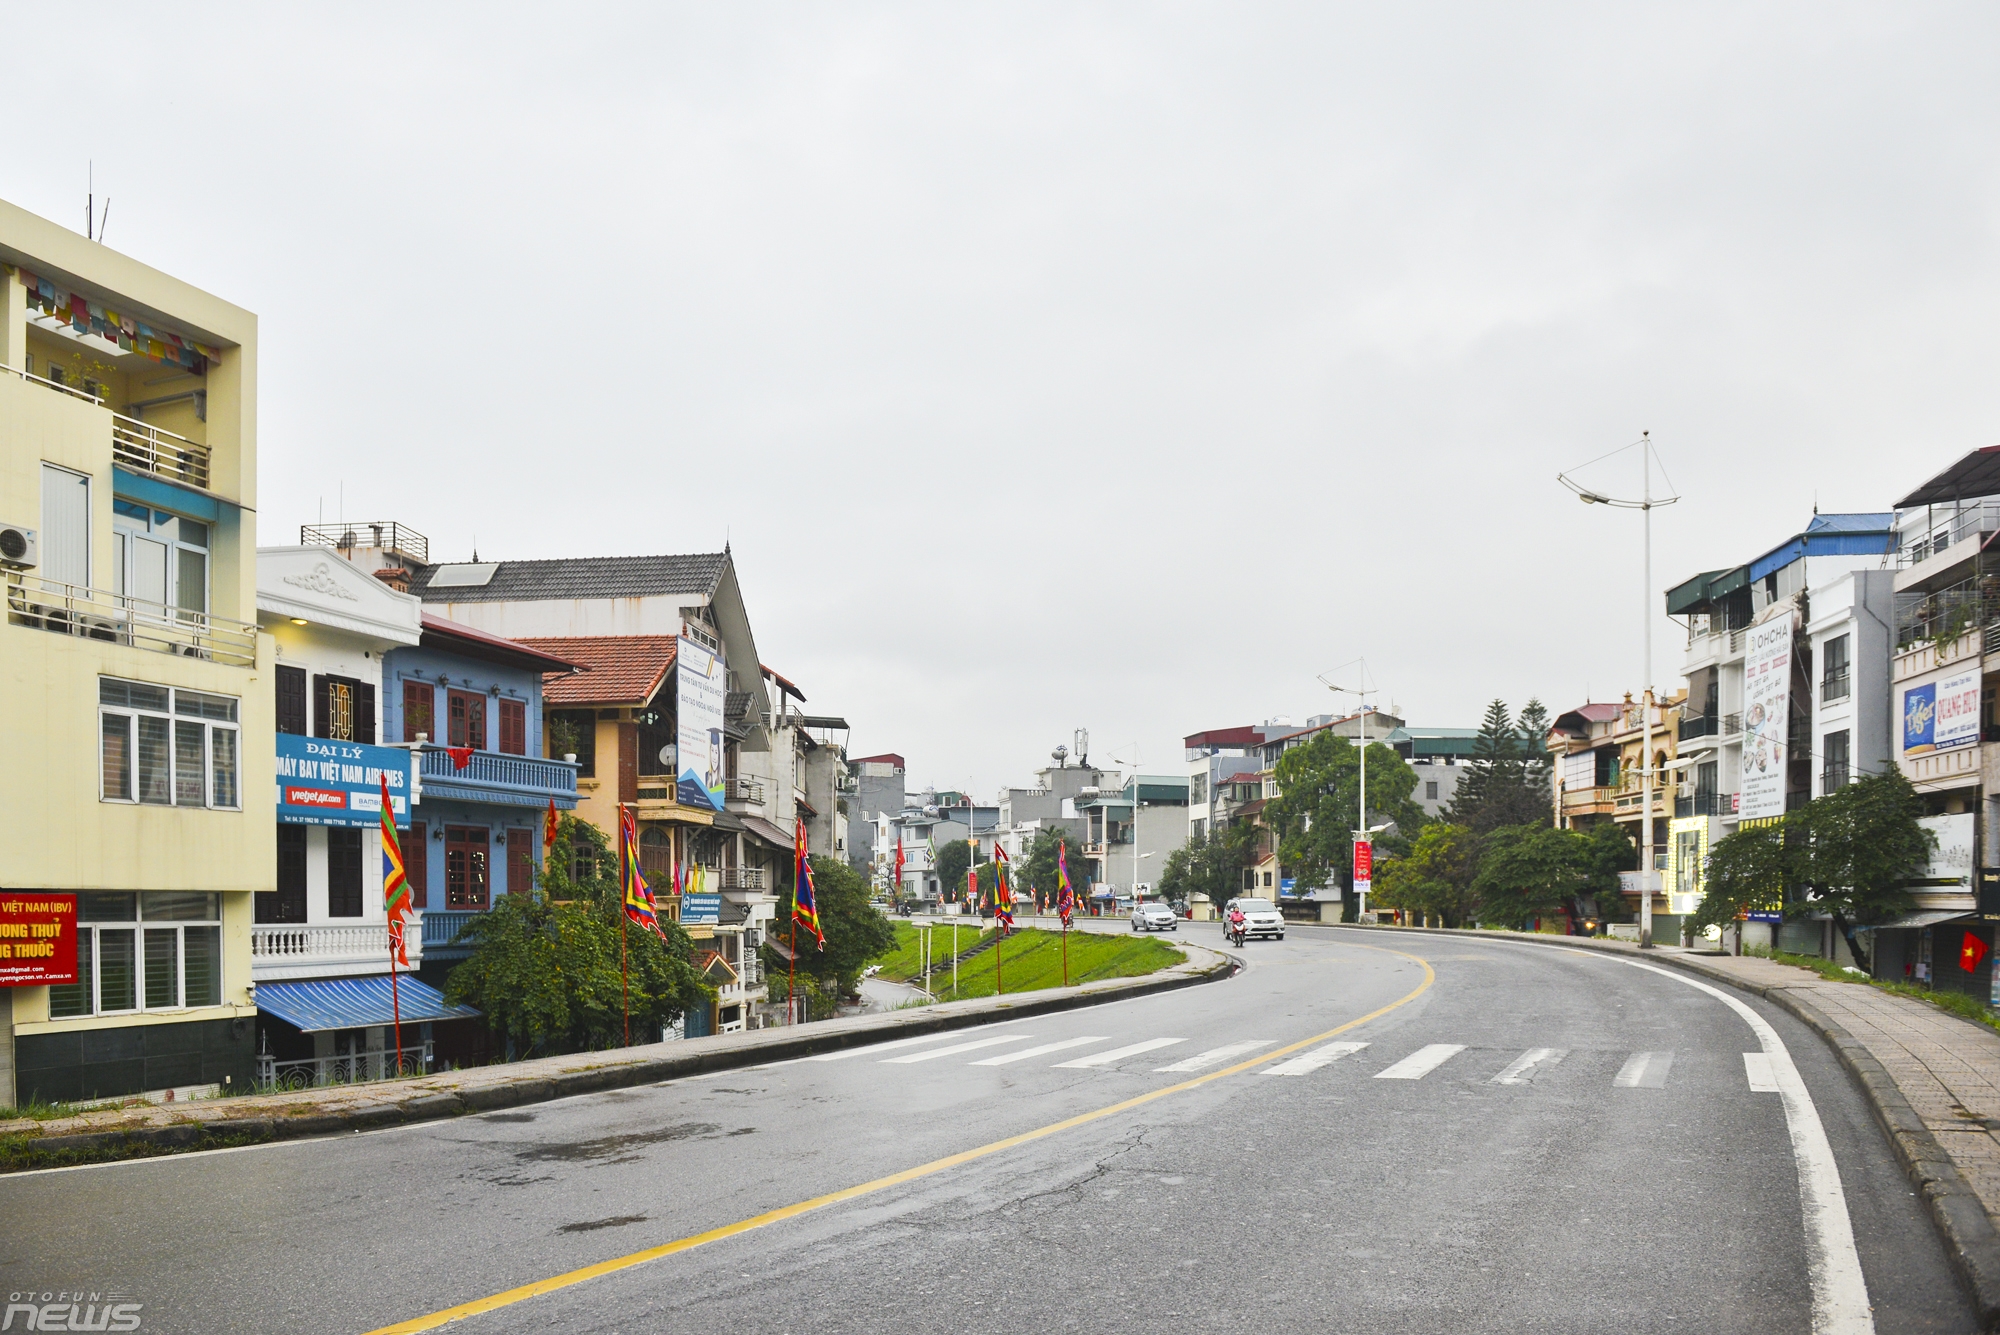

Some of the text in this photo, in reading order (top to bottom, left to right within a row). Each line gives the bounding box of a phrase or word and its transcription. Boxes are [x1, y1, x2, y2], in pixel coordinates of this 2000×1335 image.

[1758, 624, 1788, 648] OHCHA
[1905, 701, 1935, 734] Tiger
[1937, 689, 1978, 725] QUANG HUY
[306, 743, 363, 759] ĐẠI LÝ
[276, 754, 297, 777] MÁY
[300, 758, 318, 780] BAY
[320, 759, 340, 785] VIỆT
[342, 764, 363, 784] NAM
[2, 900, 72, 916] VIỆT NAM (IBV)
[30, 918, 62, 938] THUỶ
[14, 938, 54, 958] THUỐC
